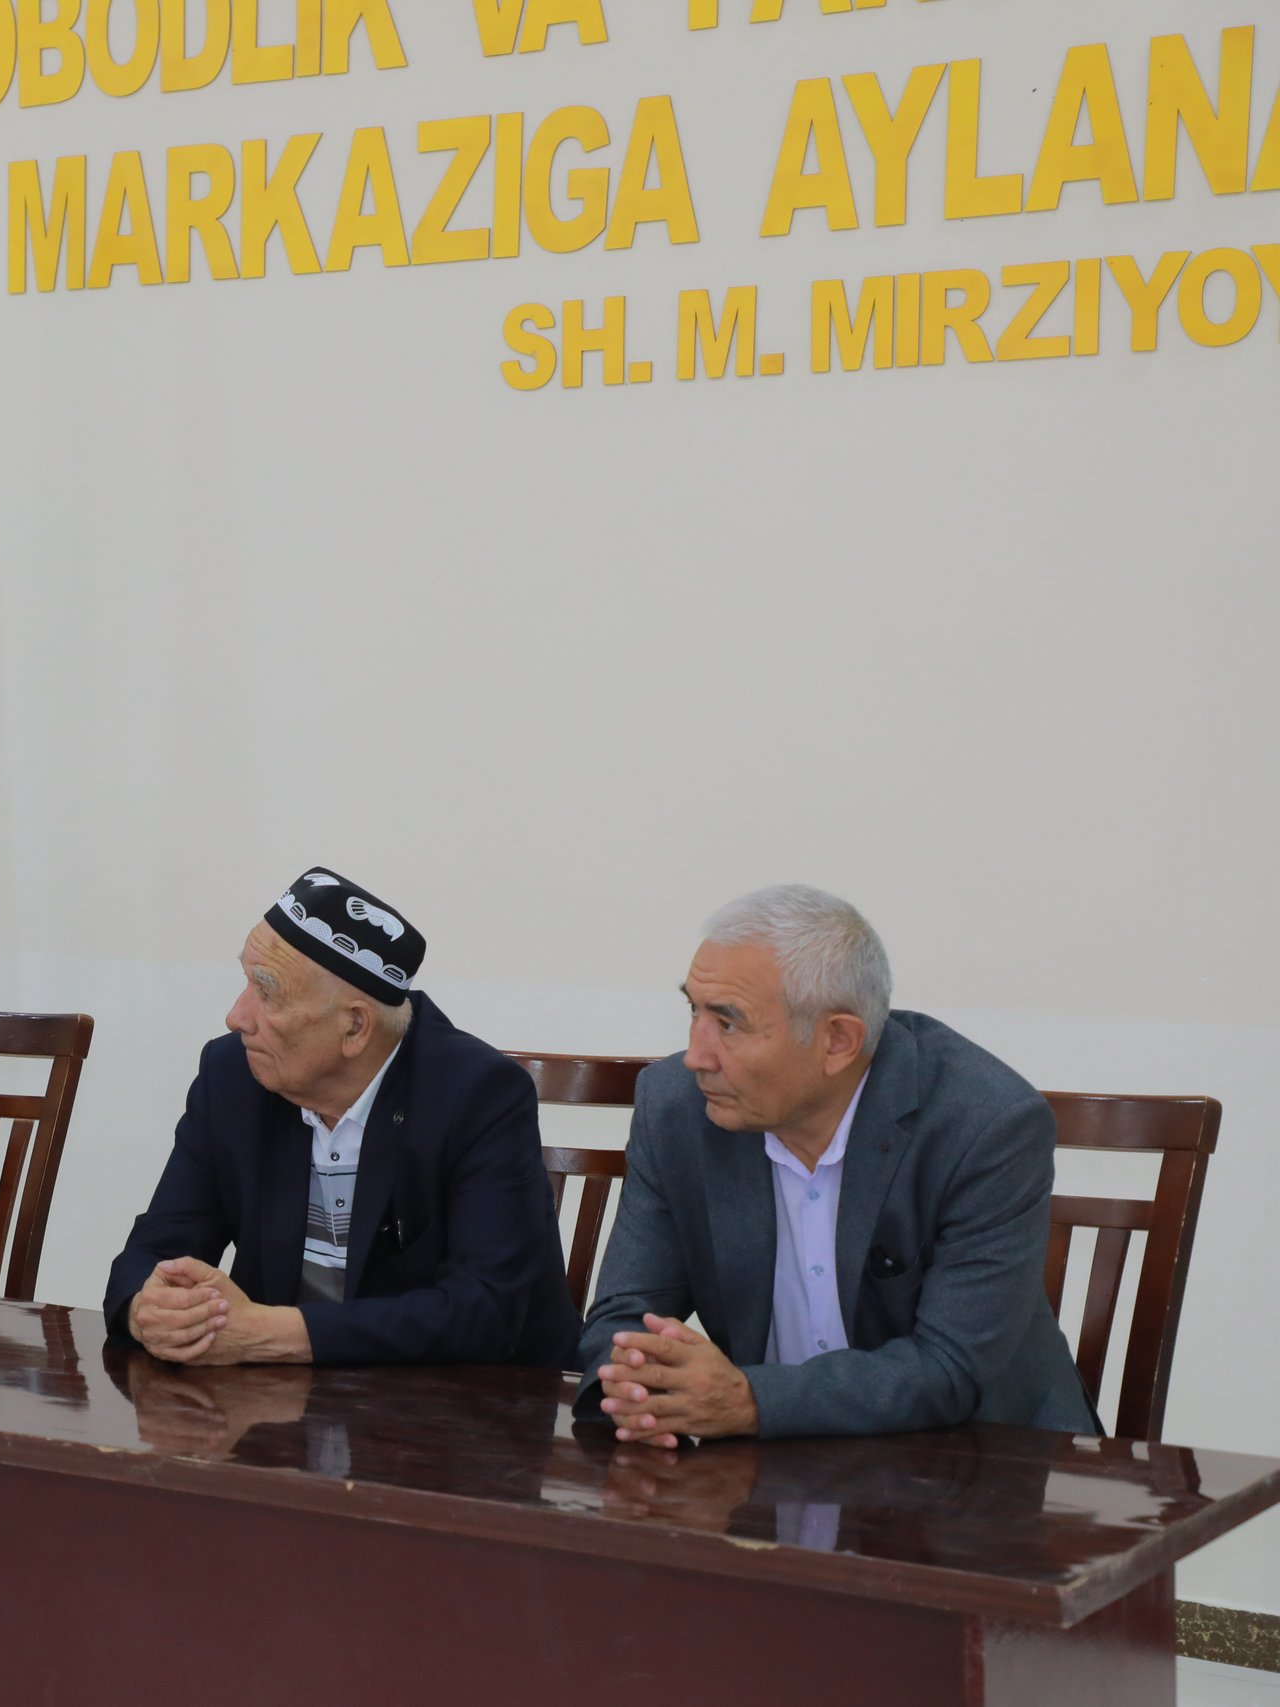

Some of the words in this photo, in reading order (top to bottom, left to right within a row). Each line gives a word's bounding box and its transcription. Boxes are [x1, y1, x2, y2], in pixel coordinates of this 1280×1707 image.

[8, 95, 700, 295] MARKAZIGA
[759, 25, 1280, 238] AYLAN
[500, 296, 652, 391] SH.
[677, 285, 784, 381] M.
